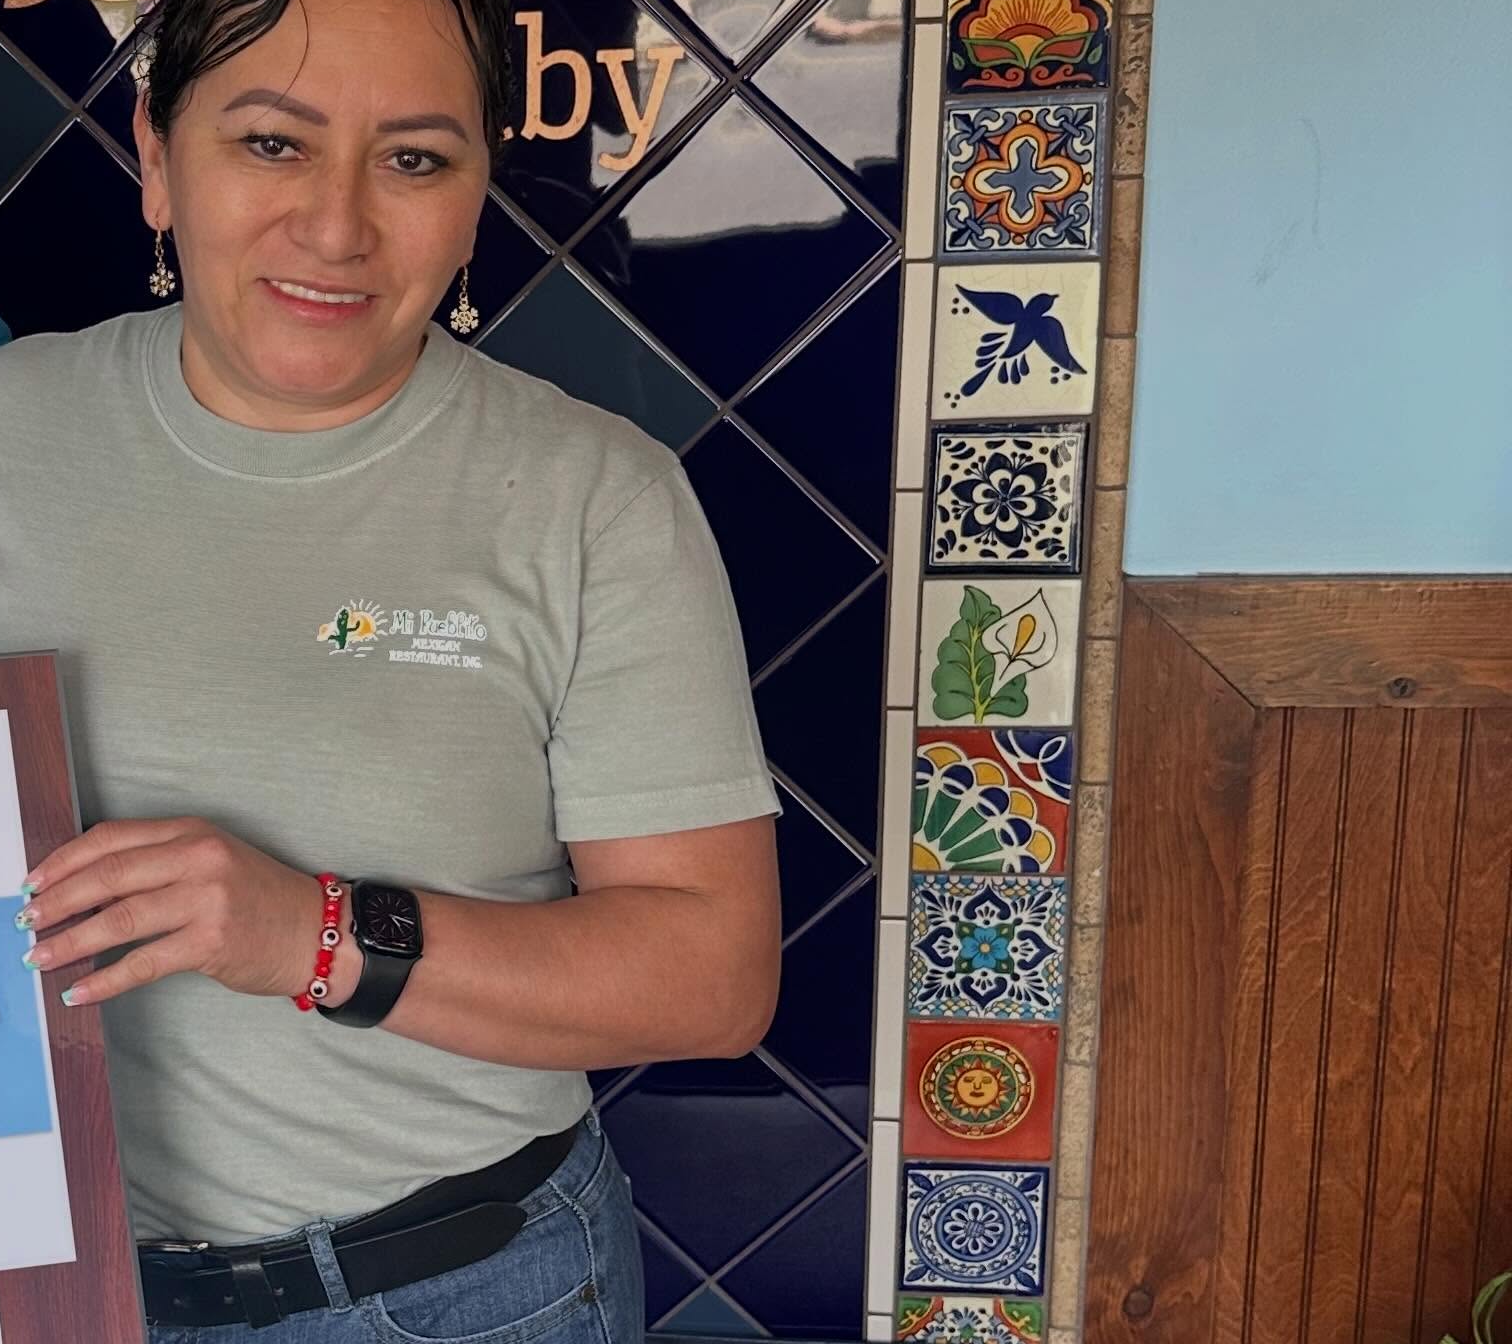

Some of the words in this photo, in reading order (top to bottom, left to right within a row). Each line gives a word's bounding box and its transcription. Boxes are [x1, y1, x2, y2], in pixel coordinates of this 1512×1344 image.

[502, 10, 685, 172] by
[389, 609, 414, 635] Mi
[419, 609, 487, 641] Pueblito
[410, 637, 461, 653] MEXICAN
